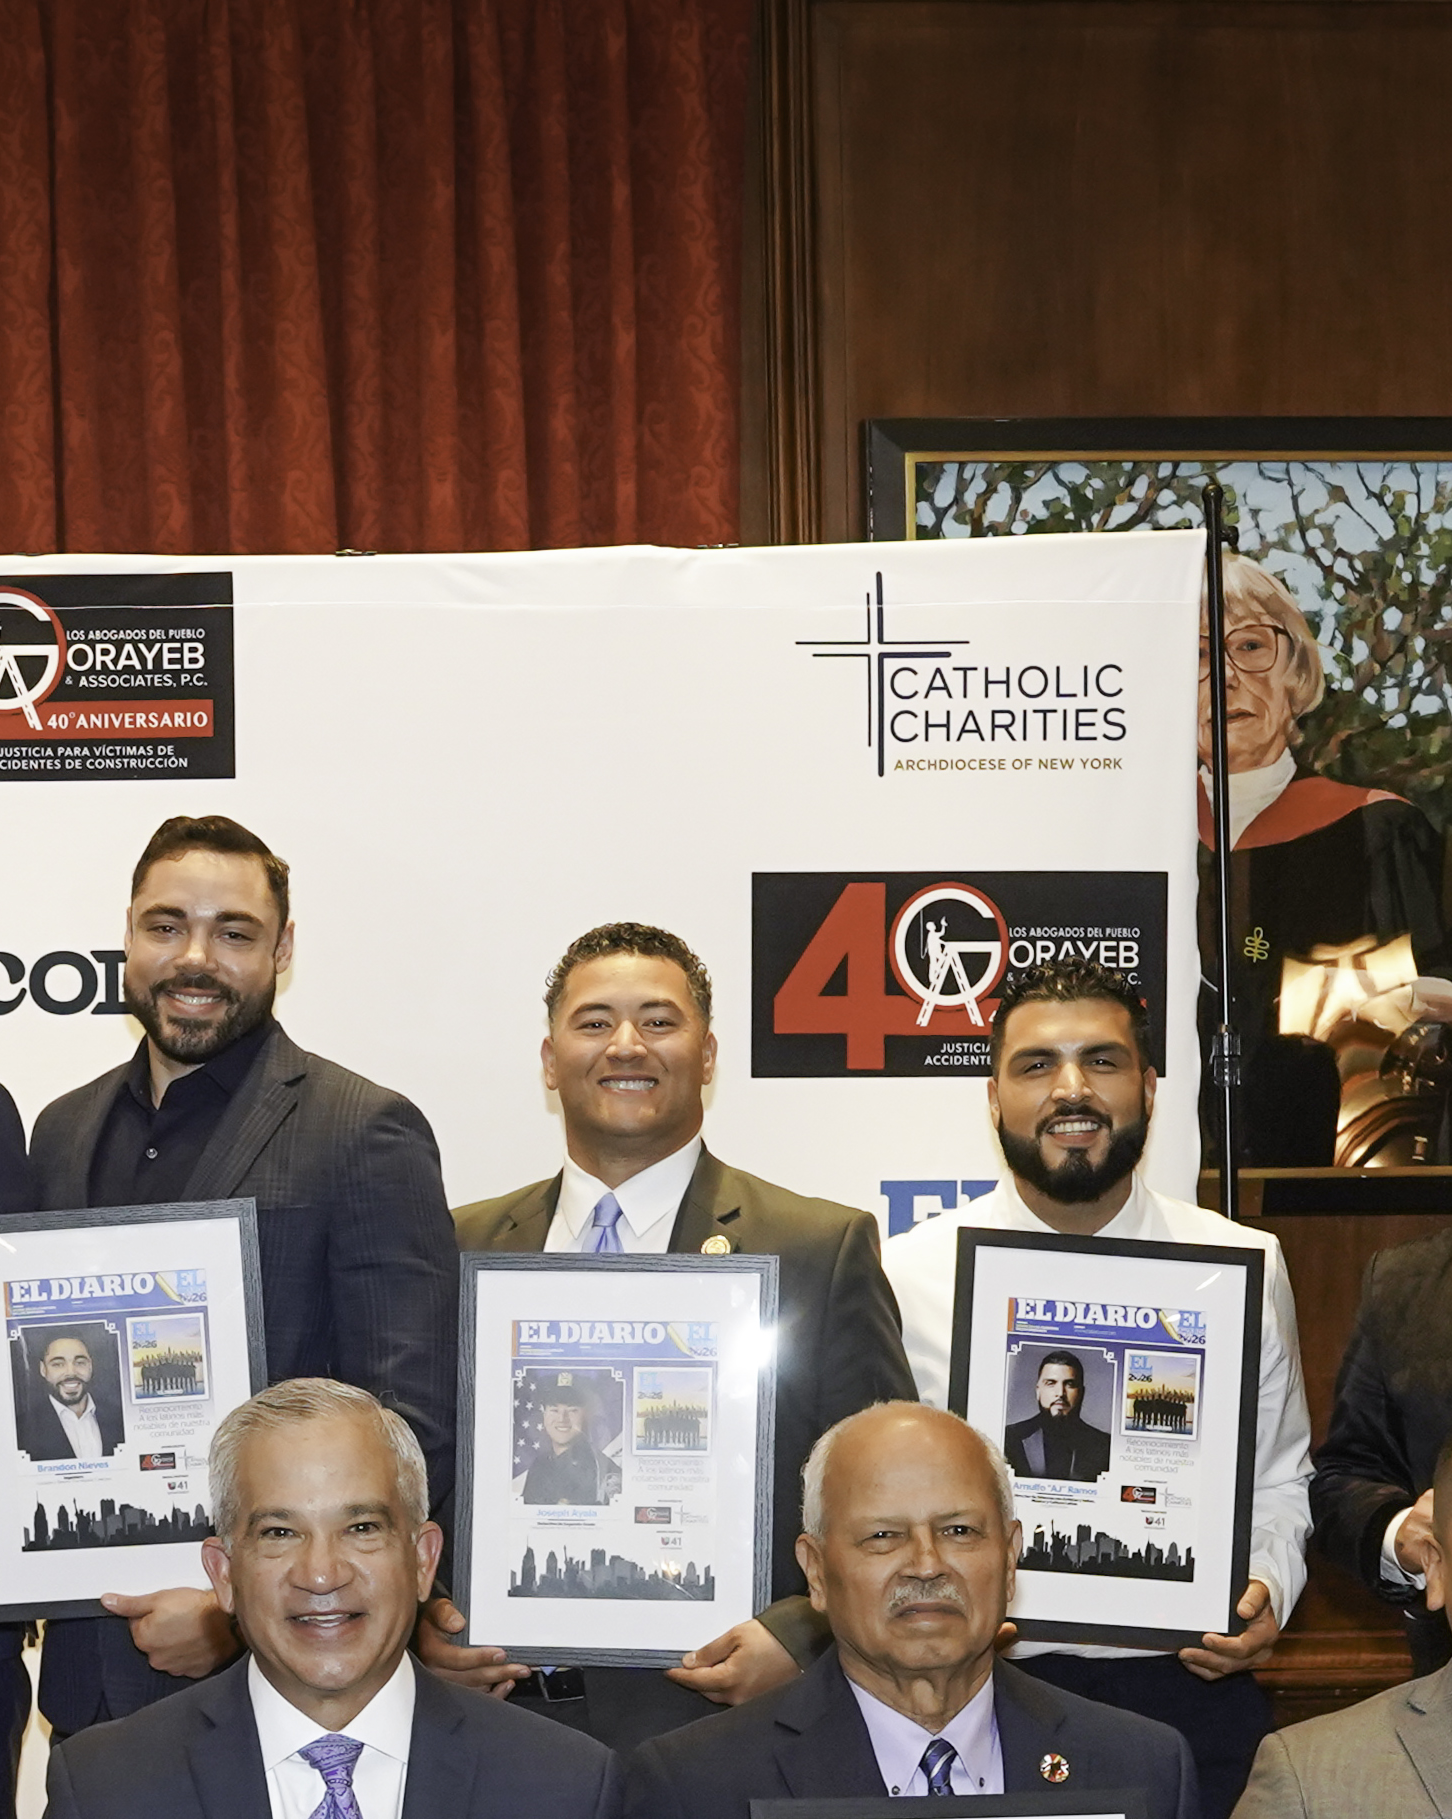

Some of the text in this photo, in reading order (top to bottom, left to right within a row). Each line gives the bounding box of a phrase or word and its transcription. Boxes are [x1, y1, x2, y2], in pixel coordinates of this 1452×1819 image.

[66, 629, 205, 640] LOS ABOGADOS DEL PUEBLO
[65, 674, 208, 688] & ASSOCIATES, P.C.
[890, 664, 1123, 700] CATHOLIC
[890, 708, 1126, 743] CHARITIES
[57, 746, 90, 757] PARA
[93, 744, 155, 756] VÍCTIMAS
[158, 745, 174, 756] DE
[65, 759, 83, 770] DE
[86, 756, 188, 769] CONSTRUCCIÓN
[894, 758, 1122, 771] ARCHDIOCESE OF NEW YORK
[1009, 927, 1140, 938] LOS ABOGADOS DEL PUEBLO
[924, 1055, 992, 1065] ACCIDENTE
[10, 1272, 154, 1303] EL DIARIO
[1015, 1299, 1157, 1328] EL DIARIO
[519, 1321, 666, 1342] EL DIARIO
[37, 1461, 108, 1472] Brandon Nieves
[1068, 1486, 1097, 1495] Ramos
